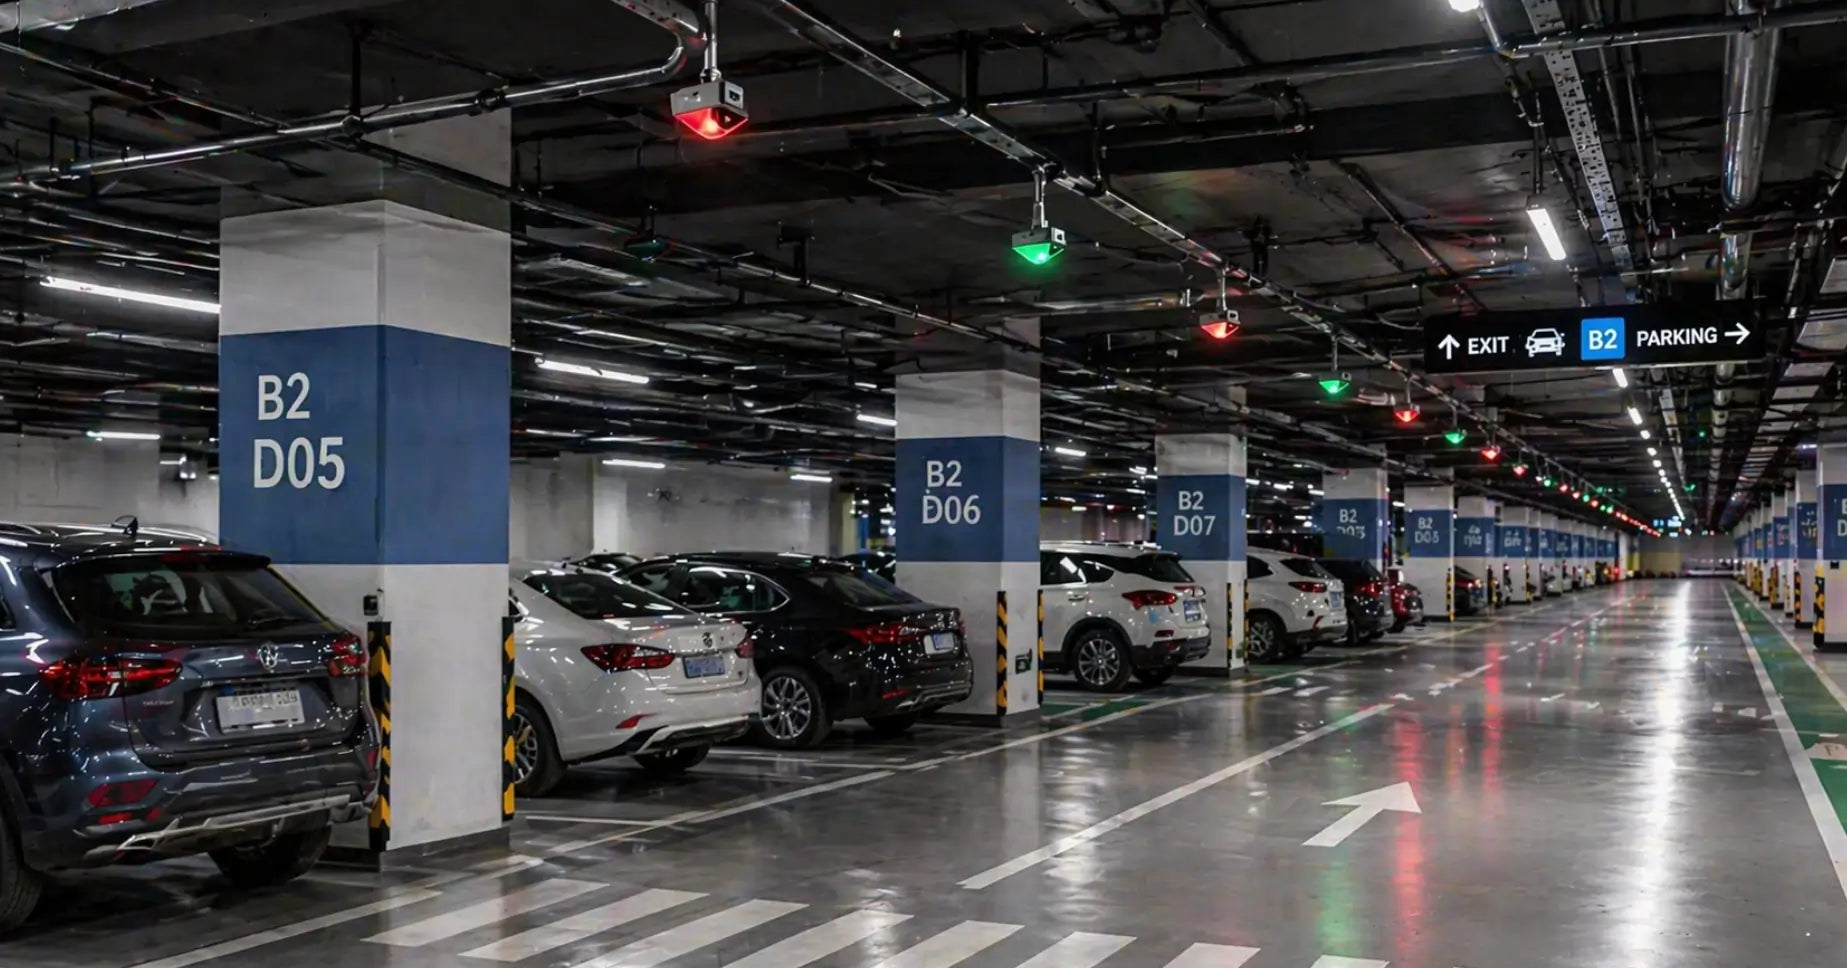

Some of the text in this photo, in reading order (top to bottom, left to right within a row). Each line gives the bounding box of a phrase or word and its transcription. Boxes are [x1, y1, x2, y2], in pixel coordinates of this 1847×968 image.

[1468, 326, 1718, 355] EXIT B2 PARKING
[258, 372, 310, 420] B2
[253, 436, 345, 489] D05
[926, 460, 963, 487] B2
[922, 494, 981, 525] D06
[1178, 490, 1204, 510] B2
[1173, 514, 1216, 536] D07
[1339, 508, 1357, 523] B2
